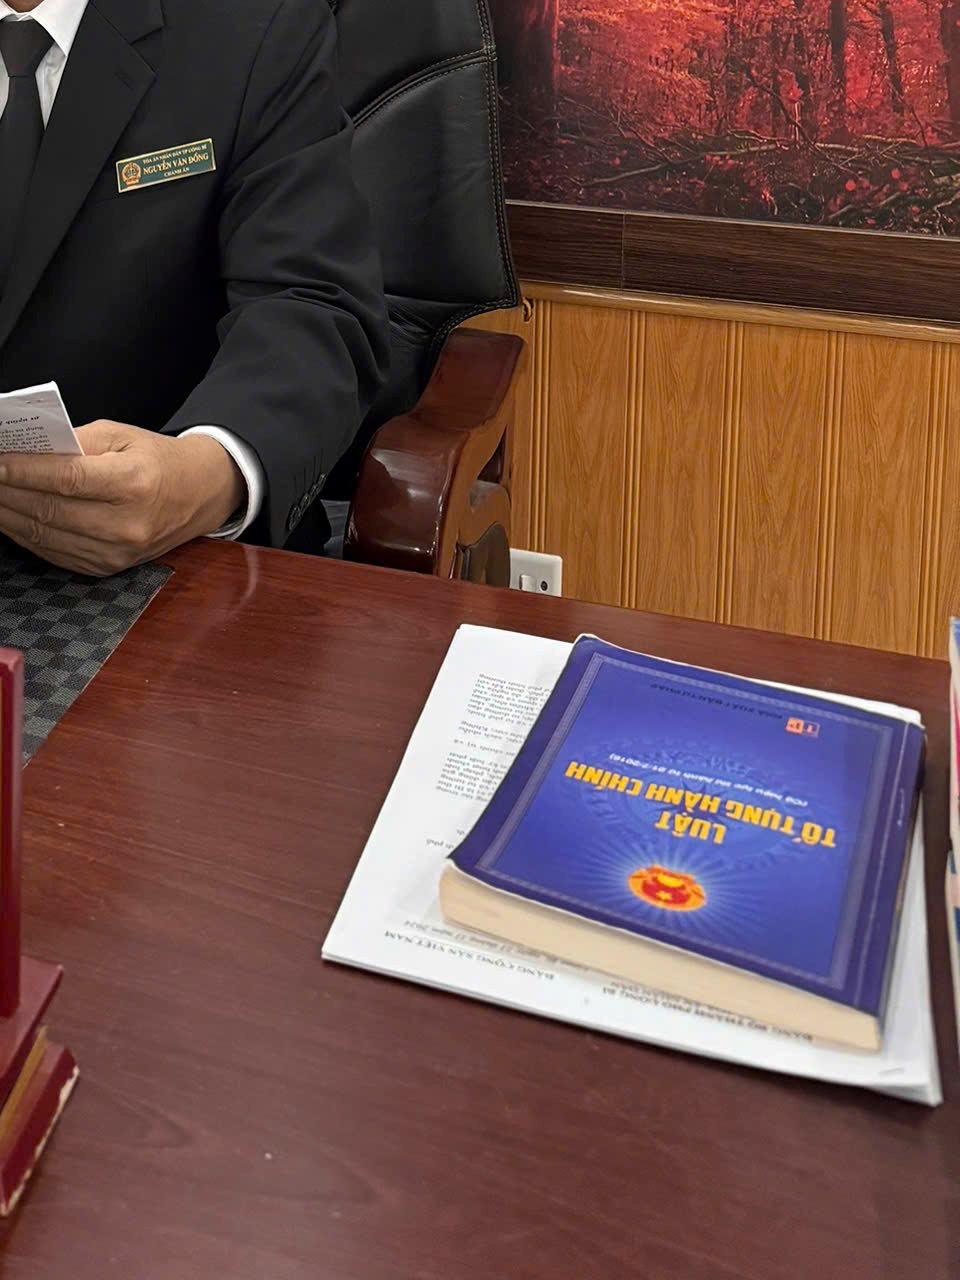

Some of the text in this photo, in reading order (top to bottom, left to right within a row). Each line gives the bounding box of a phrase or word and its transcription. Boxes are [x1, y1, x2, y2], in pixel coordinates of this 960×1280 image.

[143, 160, 173, 175] NGUYỄN
[173, 156, 188, 167] VĂN
[564, 761, 837, 848] TỐ TỤNG HÀNH CHÍNH
[655, 810, 727, 844] LUẬT
[384, 929, 414, 945] NAM
